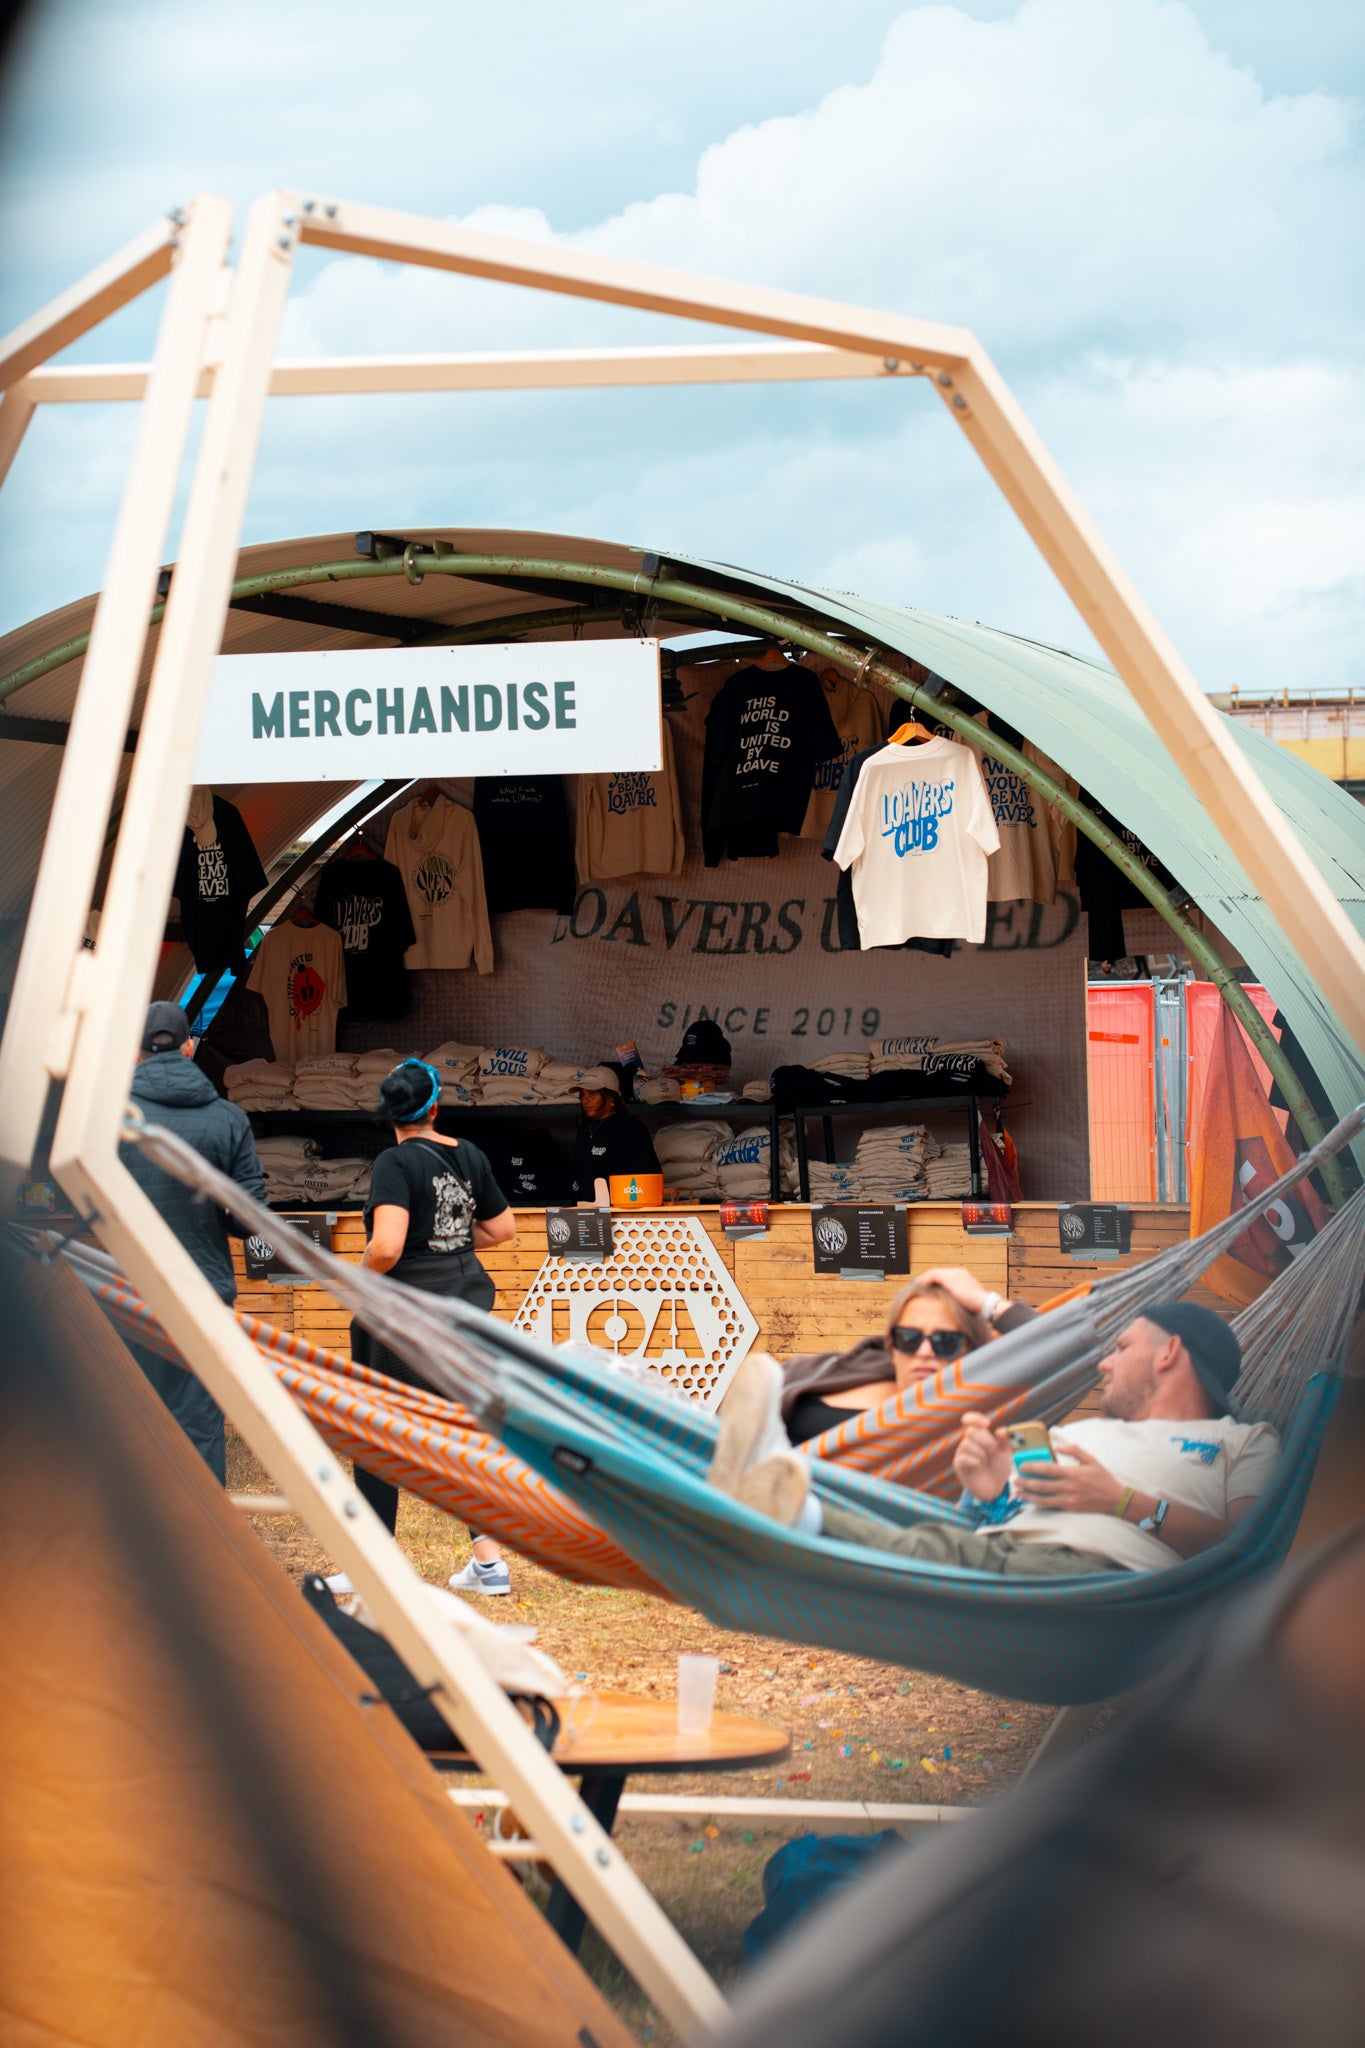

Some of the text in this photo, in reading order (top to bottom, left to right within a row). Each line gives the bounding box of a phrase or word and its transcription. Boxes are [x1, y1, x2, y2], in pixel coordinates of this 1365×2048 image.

[252, 681, 577, 739] MERCHANDISE
[746, 696, 777, 711] THIS
[740, 708, 790, 725] WORLD
[765, 721, 781, 734] IS
[740, 733, 792, 750] UNITED
[747, 746, 763, 760] BY
[736, 758, 780, 775] LOAVE
[608, 787, 657, 815] LOAVER
[880, 778, 955, 837] LOAVERS
[992, 804, 1038, 828] AVER
[895, 816, 938, 858] CLUB
[417, 868, 453, 892] OPEN
[791, 1006, 882, 1037] 2019
[494, 1048, 528, 1064] WILL
[483, 1058, 519, 1075] YOU
[819, 1227, 845, 1244] OPEN
[824, 1241, 842, 1251] AIR
